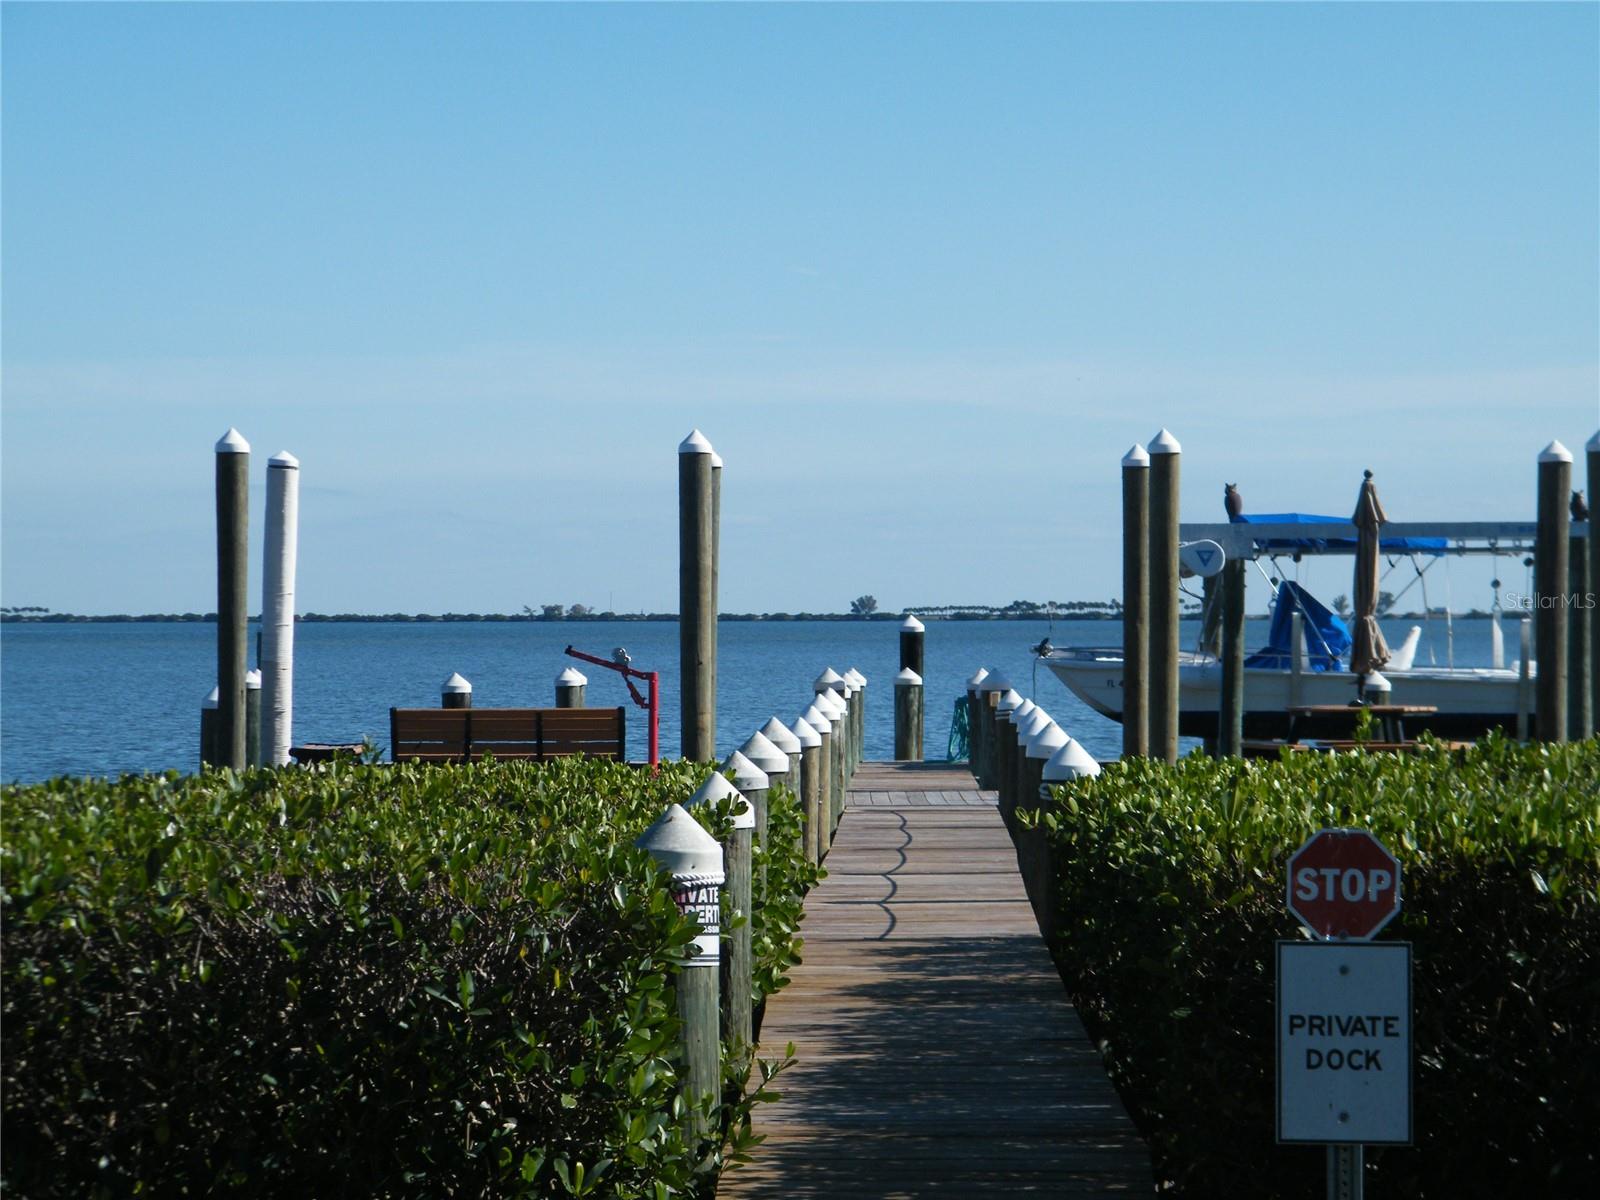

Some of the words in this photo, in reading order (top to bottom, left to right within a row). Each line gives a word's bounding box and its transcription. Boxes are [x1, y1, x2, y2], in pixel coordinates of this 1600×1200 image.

[676, 886, 719, 903] IVATE
[1295, 867, 1392, 902] STOP
[1289, 1015, 1400, 1038] PRIVATE
[1306, 1048, 1383, 1071] DOCK
